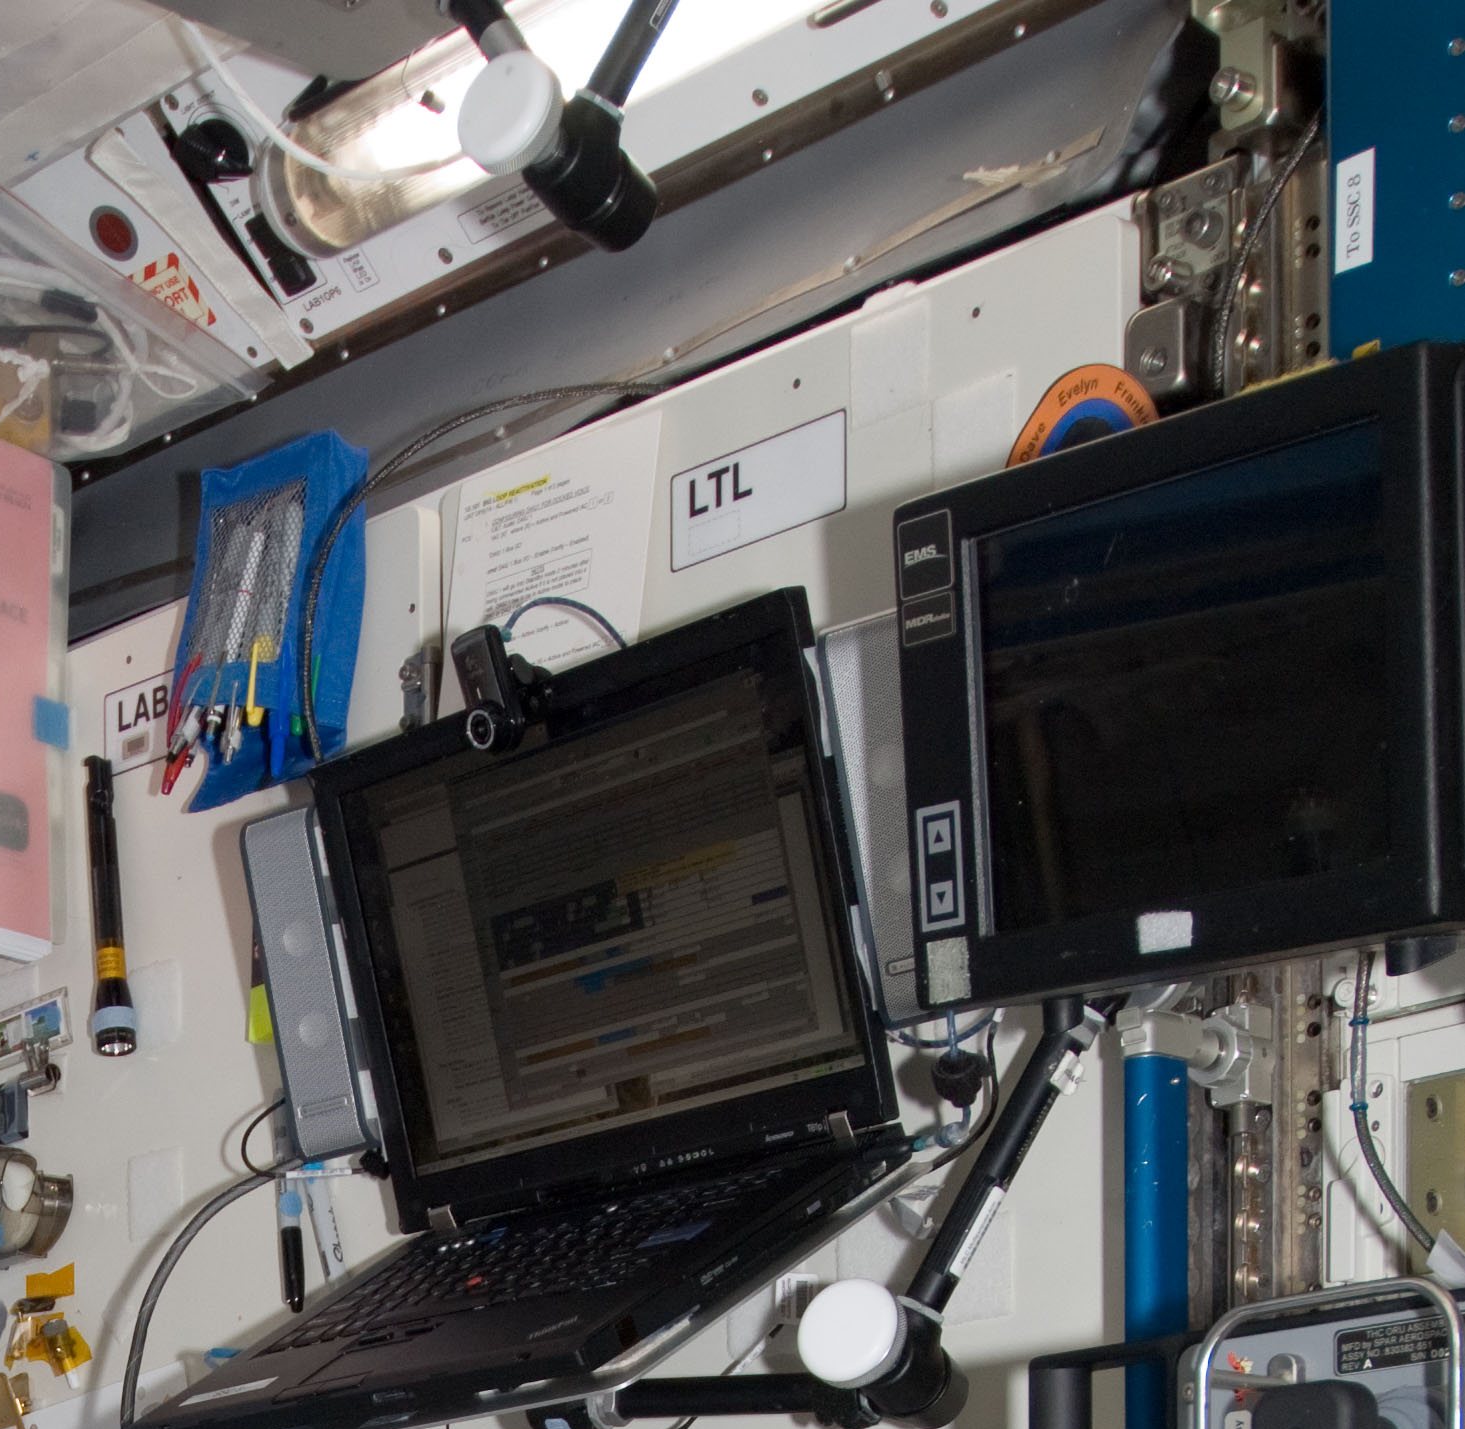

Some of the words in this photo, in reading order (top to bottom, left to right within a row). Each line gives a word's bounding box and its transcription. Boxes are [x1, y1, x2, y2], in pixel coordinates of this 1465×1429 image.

[1347, 174, 1361, 187] 8
[1347, 192, 1361, 226] SSC
[1347, 231, 1361, 258] To
[164, 276, 181, 290] USE
[164, 288, 189, 308] ORT
[1057, 379, 1098, 407] Evelyn
[1020, 423, 1046, 462] Dave
[688, 462, 753, 519] LTL
[904, 543, 937, 565] EMS
[118, 685, 169, 733] LAB
[1341, 1341, 1361, 1352] MFD
[1374, 1335, 1397, 1347] SPAR
[1362, 1358, 1373, 1370] A
